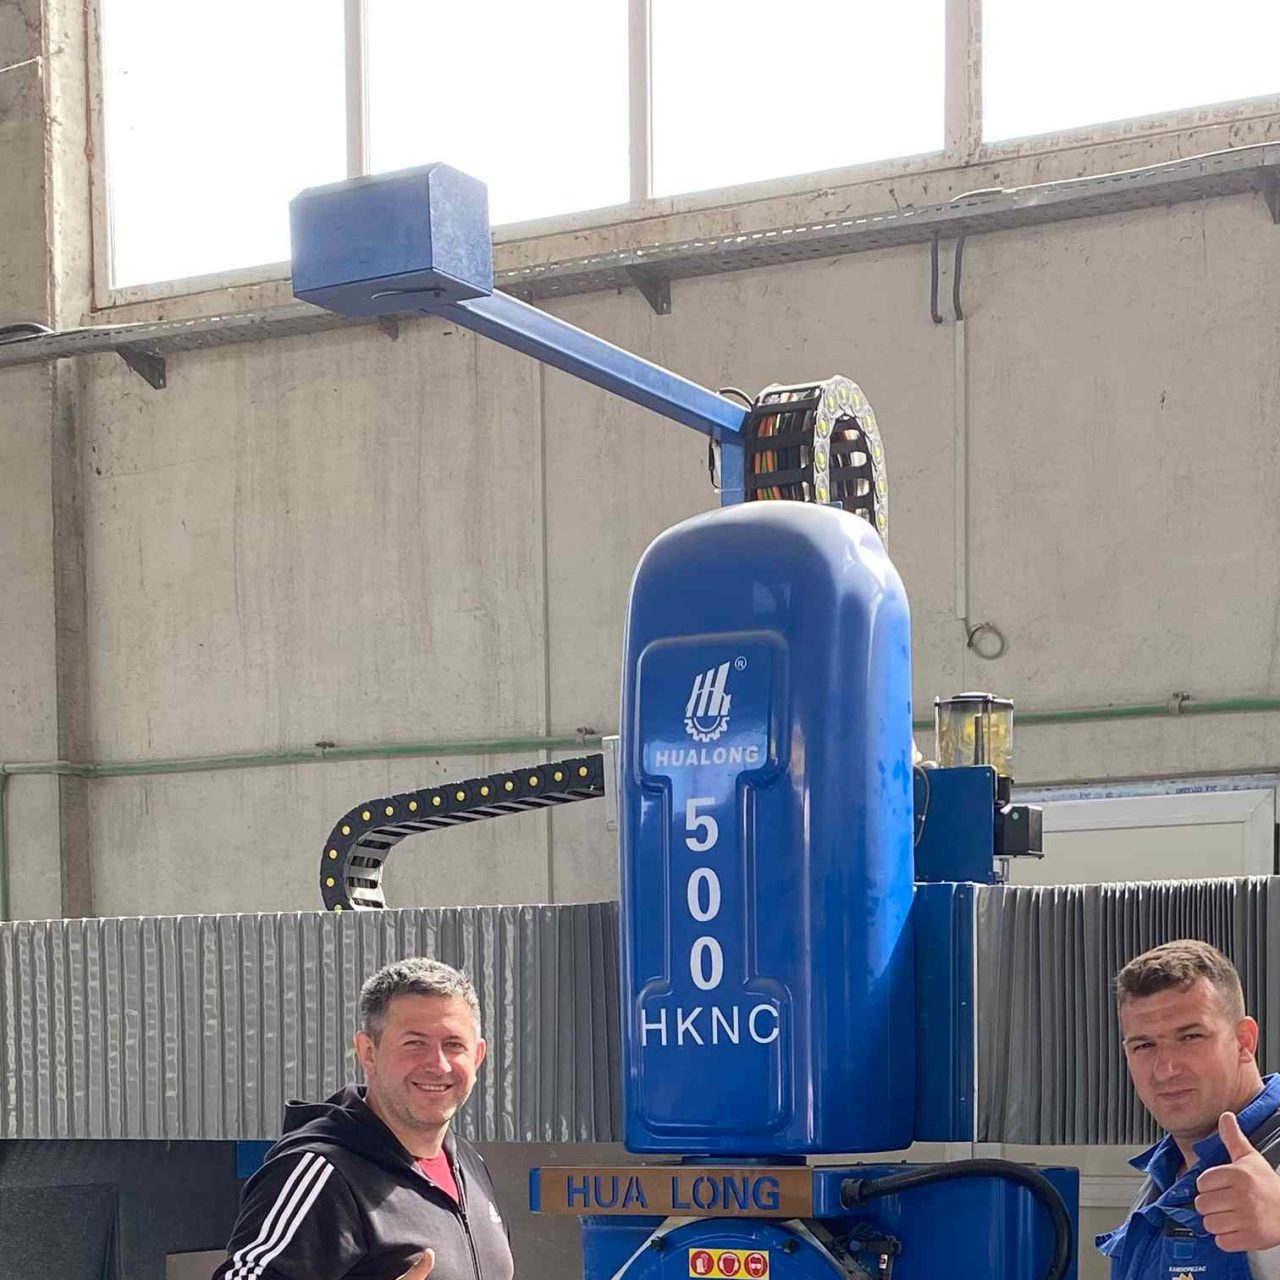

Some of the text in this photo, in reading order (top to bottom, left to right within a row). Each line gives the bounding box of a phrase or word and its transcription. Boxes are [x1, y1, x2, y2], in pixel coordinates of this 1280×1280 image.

[655, 745, 759, 768] HUALONG
[641, 1004, 780, 1047] HKNC
[567, 1175, 780, 1211] HUA LONG
